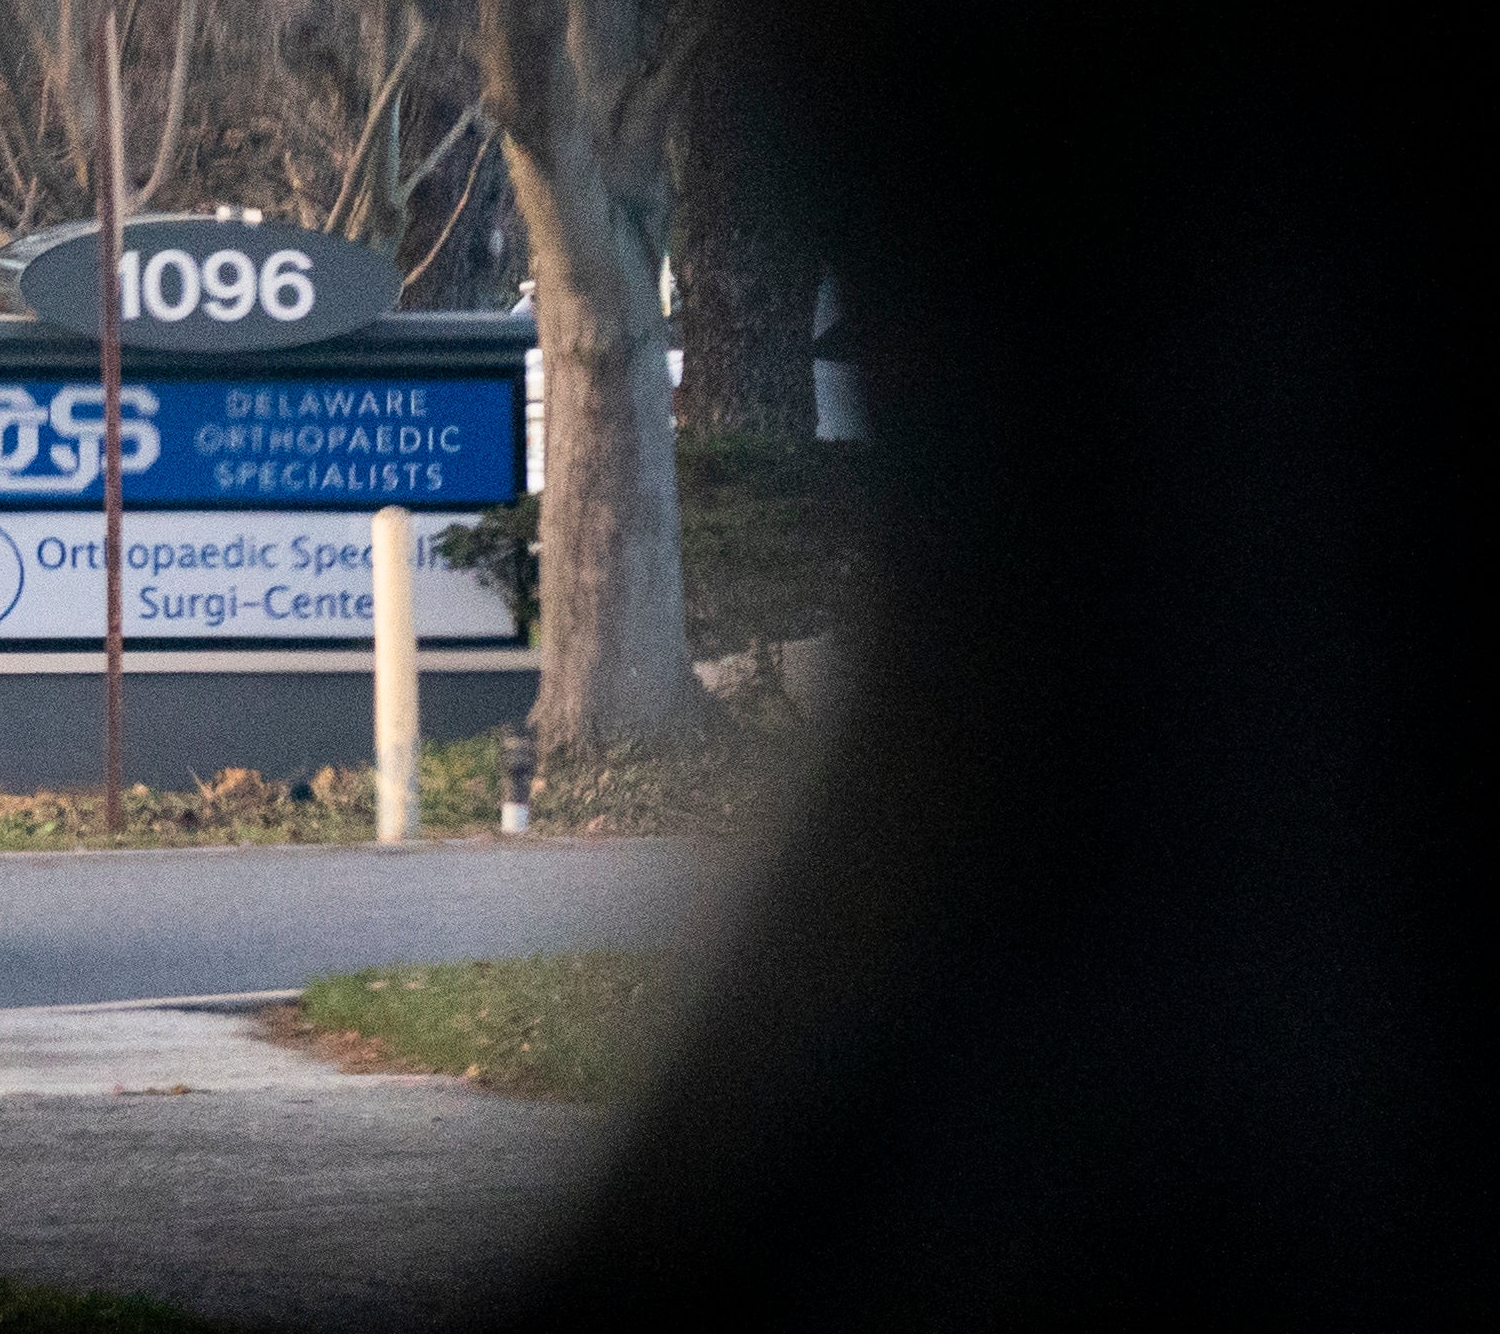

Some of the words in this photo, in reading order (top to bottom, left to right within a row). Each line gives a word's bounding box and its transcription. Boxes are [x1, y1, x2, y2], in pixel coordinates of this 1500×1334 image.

[117, 249, 316, 322] 1096
[226, 388, 428, 418] DELAWARE
[194, 425, 461, 455] ORTHOPAEDIC
[214, 461, 443, 492] SPECIALISTS
[140, 585, 375, 627] Surgi-Cente
